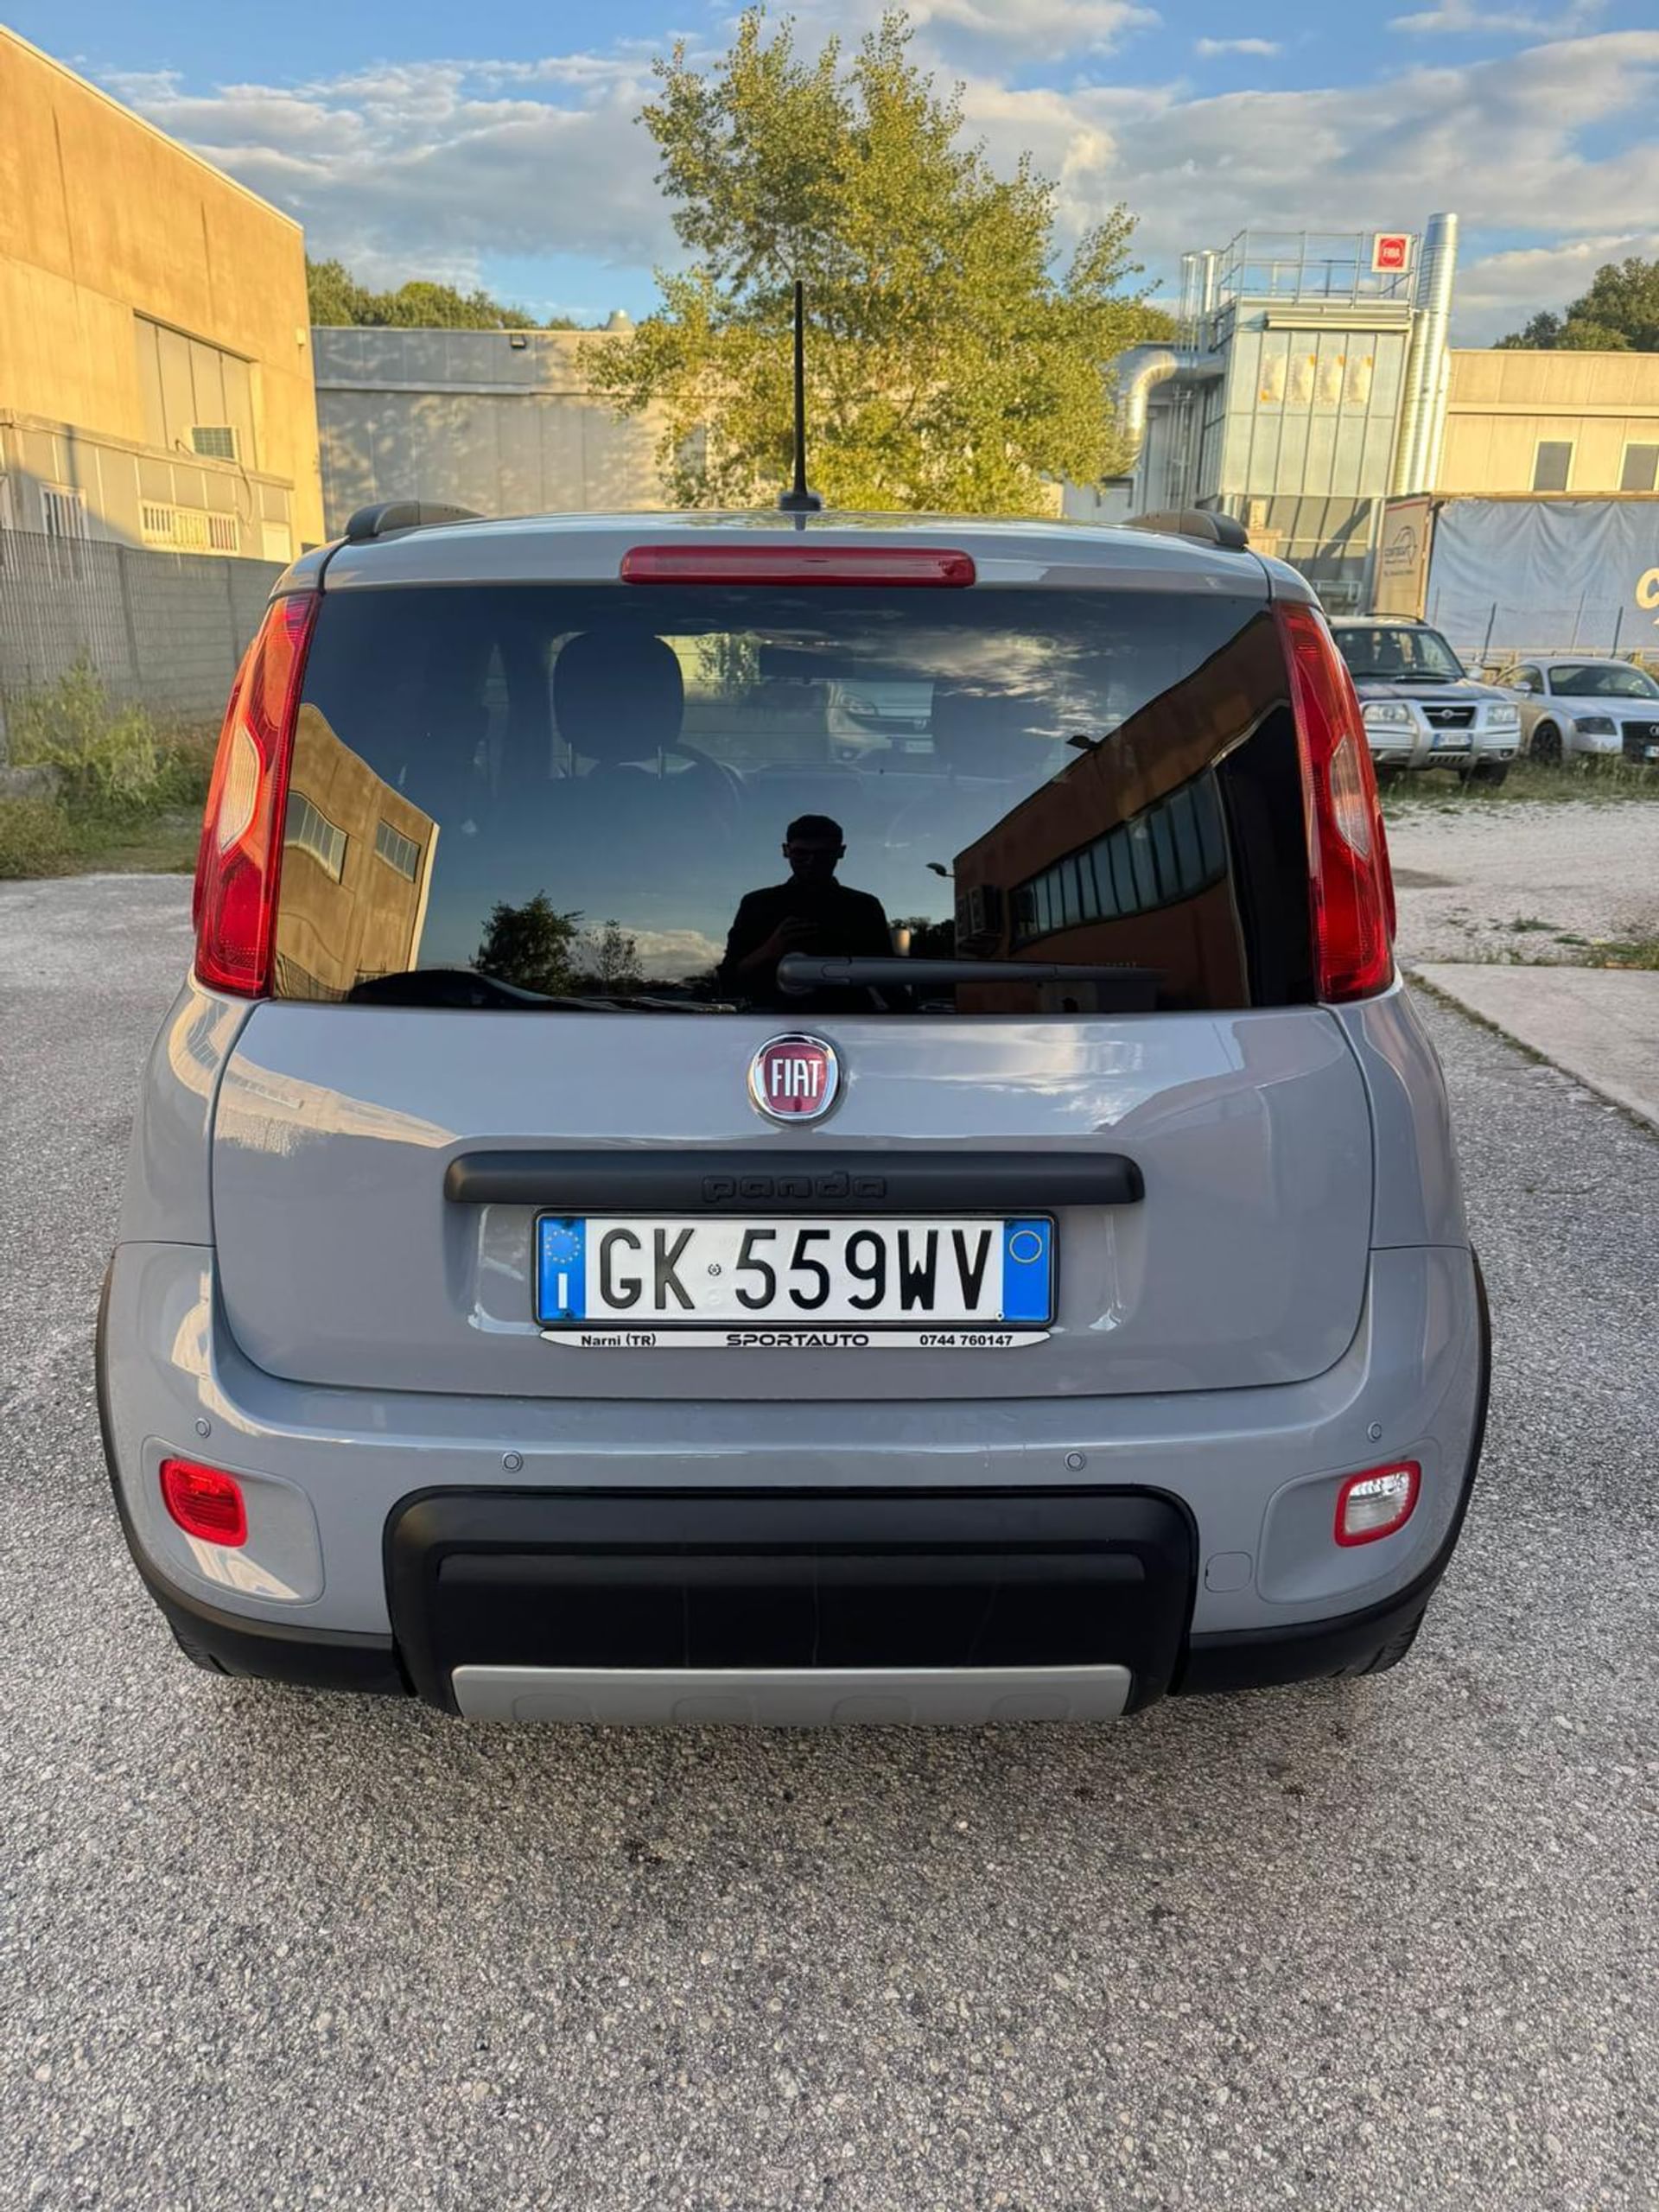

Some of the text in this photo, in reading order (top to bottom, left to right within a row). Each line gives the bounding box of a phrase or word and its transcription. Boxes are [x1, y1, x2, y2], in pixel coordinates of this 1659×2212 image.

[772, 1058, 823, 1096] FIAT
[702, 1171, 887, 1202] panda
[600, 1228, 993, 1311] GK 559WV
[558, 1272, 568, 1309] I
[581, 1333, 657, 1346] Narni (TR)
[726, 1333, 869, 1346] SPORTAUTO
[919, 1334, 1014, 1345] 0744 760147
